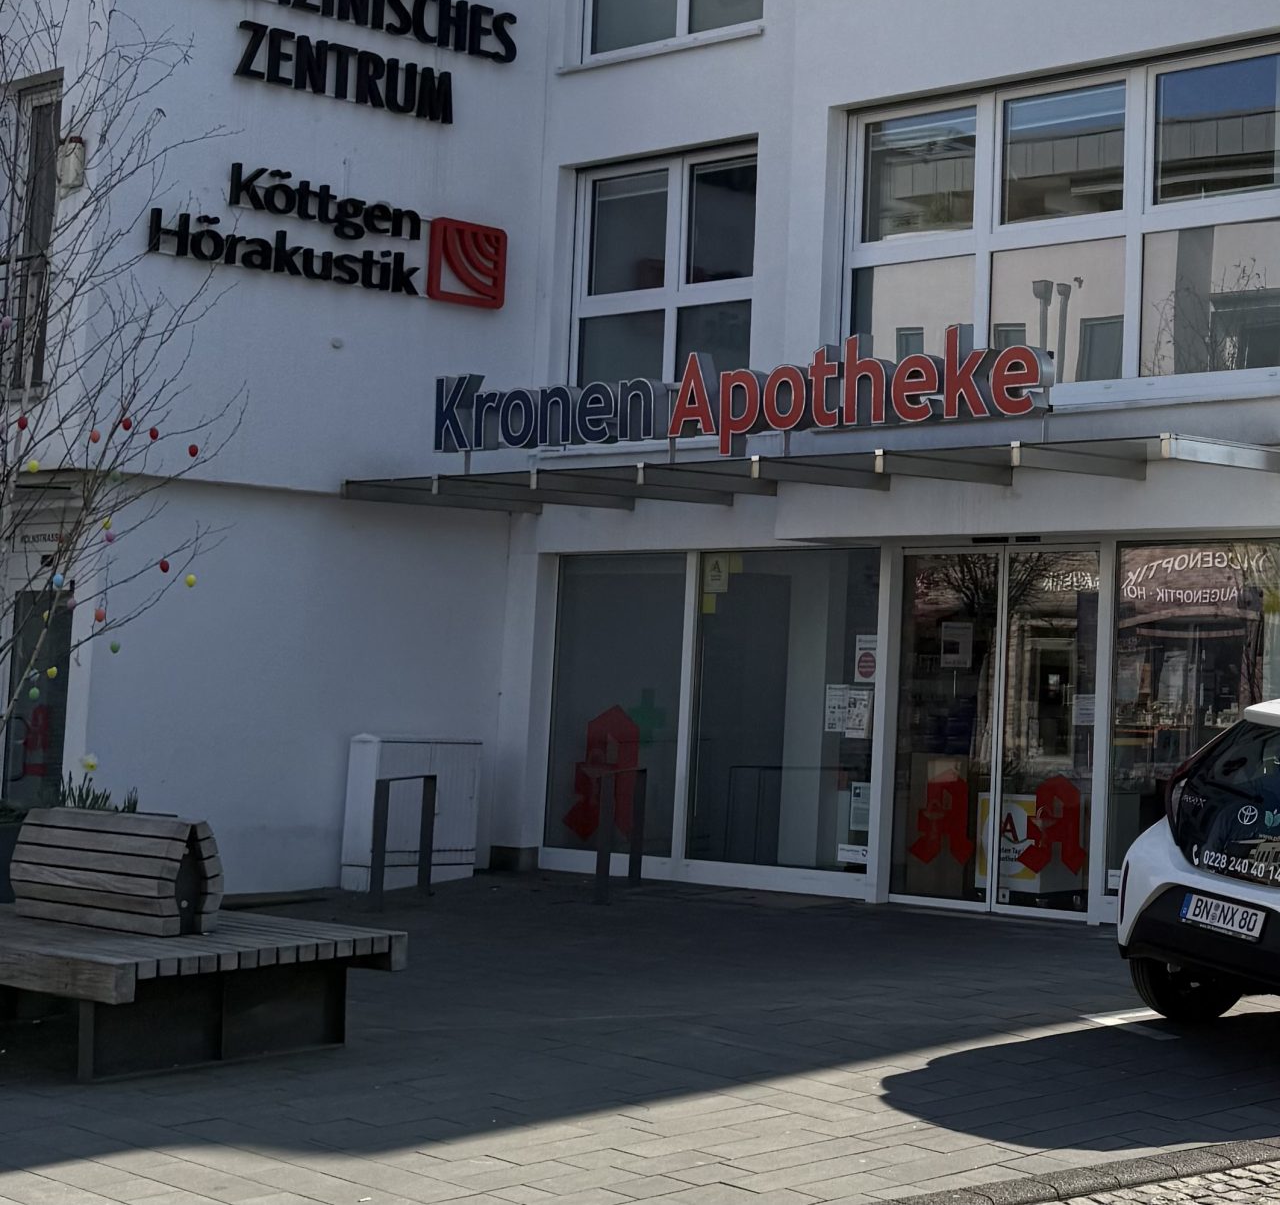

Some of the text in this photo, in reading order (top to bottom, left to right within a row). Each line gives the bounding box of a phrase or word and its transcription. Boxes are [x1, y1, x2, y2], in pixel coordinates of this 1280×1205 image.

[234, 20, 453, 124] ZENTRUM
[434, 323, 1046, 456] Kronen Apotheke
[1203, 850, 1227, 868] 0228
[1228, 856, 1249, 873] 240
[1250, 863, 1265, 878] 40
[1192, 897, 1214, 920] BN
[1217, 904, 1239, 927] NX
[1238, 910, 1259, 932] 80
